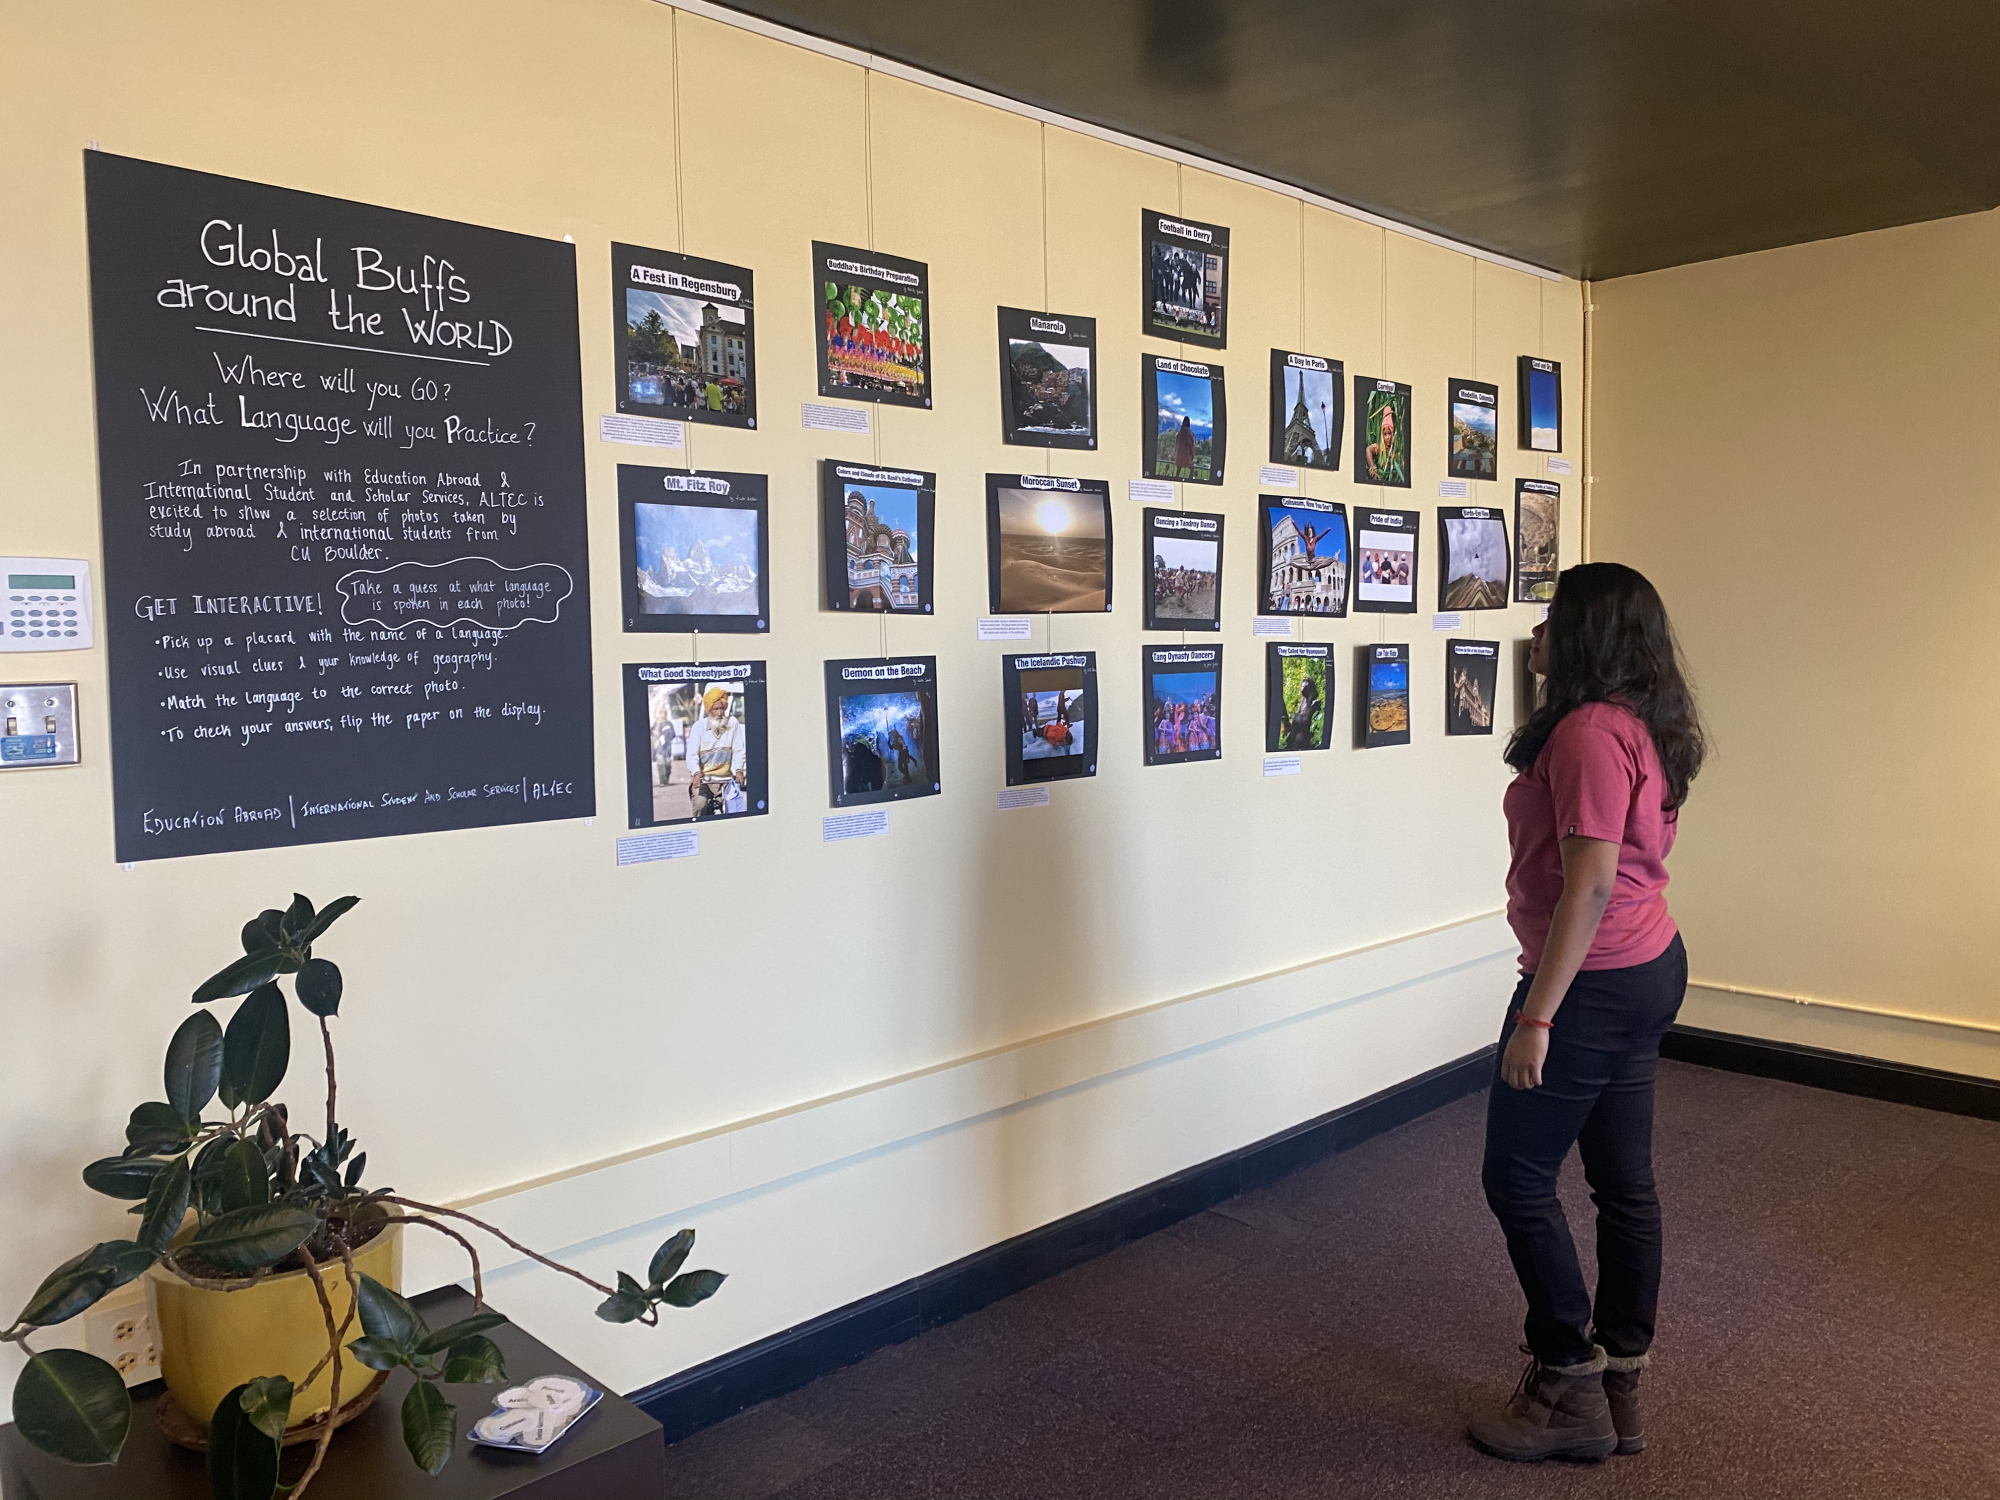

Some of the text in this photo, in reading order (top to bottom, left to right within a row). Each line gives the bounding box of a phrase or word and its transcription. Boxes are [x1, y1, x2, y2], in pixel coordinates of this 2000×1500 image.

[1160, 221, 1210, 242] Football in Derry
[201, 220, 470, 311] Global Buffs
[829, 260, 918, 285] Buddha's Birthday Preparation
[633, 268, 737, 299] A Fest in Regensburg
[157, 279, 512, 356] around the WORLD
[1031, 319, 1064, 332] Manarola
[1157, 359, 1209, 376] Land of Chocolate
[1289, 356, 1325, 369] A Day in Paris
[213, 352, 305, 388] Where
[320, 368, 356, 393] will
[367, 382, 401, 411] you
[140, 386, 223, 425] What
[239, 395, 356, 444] Language
[363, 416, 392, 438] will
[400, 426, 436, 449] you
[178, 459, 481, 487] In partnership with Education Abroad
[837, 467, 851, 476] Colors
[851, 469, 860, 477] and
[860, 470, 874, 479] Clouds
[902, 475, 922, 484] Cathedral
[1022, 475, 1078, 489] Moroccan Sunset
[143, 482, 527, 507] International Student and Scholar Services, ALTEC
[666, 477, 728, 495] Mt. Fitz Roy
[150, 504, 516, 535] excited to show selection of photos taken by
[1156, 517, 1175, 527] Dancing
[1200, 521, 1215, 529] Dance
[1371, 514, 1402, 525] Pride of India
[150, 522, 499, 551] study abroad international students from
[291, 544, 388, 561] CU Boulder.
[351, 579, 552, 599] Take guess at what language
[135, 593, 322, 621] GET INTERACTIVE!
[373, 594, 530, 616] is spoken in each photo!
[162, 627, 508, 654] Pick up placard with the name of language.
[165, 651, 497, 679] Use visual clues your knowledge of geography.
[1016, 656, 1086, 668] The Icelandic Pushup
[1153, 651, 1214, 663] Tang Dynasty Dancers
[640, 668, 747, 678] What Good Stereotypes Do?
[844, 667, 872, 678] Demon
[875, 668, 884, 677] on
[901, 665, 922, 675] Beach
[168, 680, 465, 713] Match the language to the correct photo.
[166, 702, 545, 746] To check your answers, flip the paper on the display.
[533, 780, 572, 800] ALTEC
